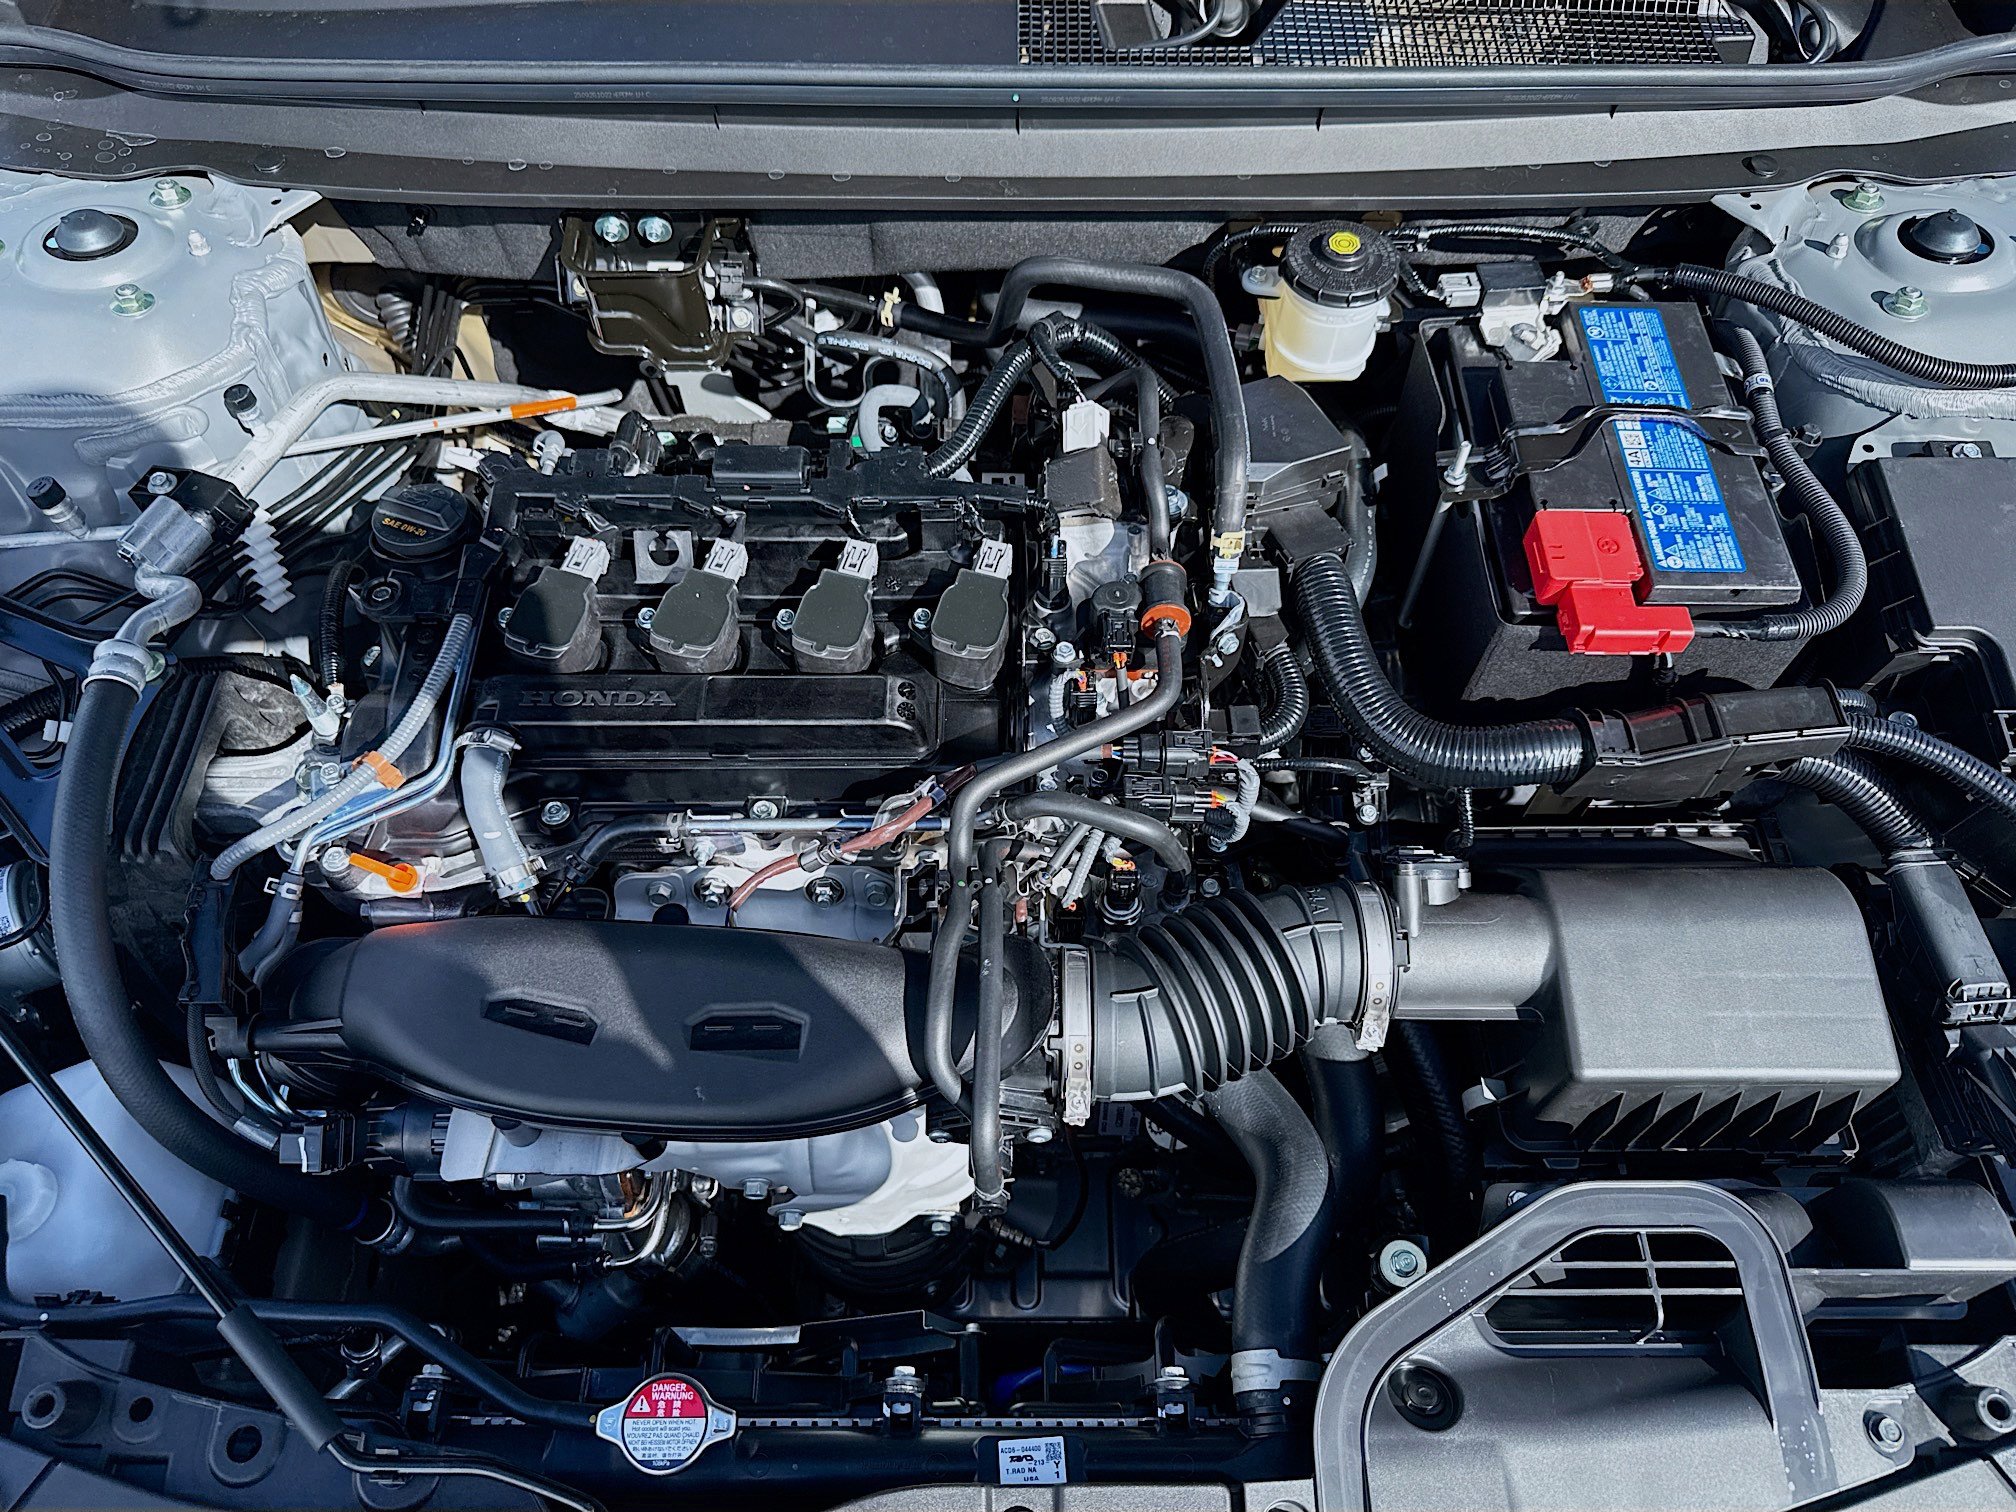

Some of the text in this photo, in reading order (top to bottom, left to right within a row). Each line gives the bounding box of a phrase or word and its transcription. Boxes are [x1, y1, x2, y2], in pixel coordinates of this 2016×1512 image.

[1628, 451, 1641, 465] 4A
[382, 518, 427, 537] SAE 0W-20
[518, 690, 677, 706] HONDA
[652, 1392, 694, 1400] WARNUNG
[1054, 1461, 1061, 1469] Y
[1054, 1470, 1060, 1479] 1
